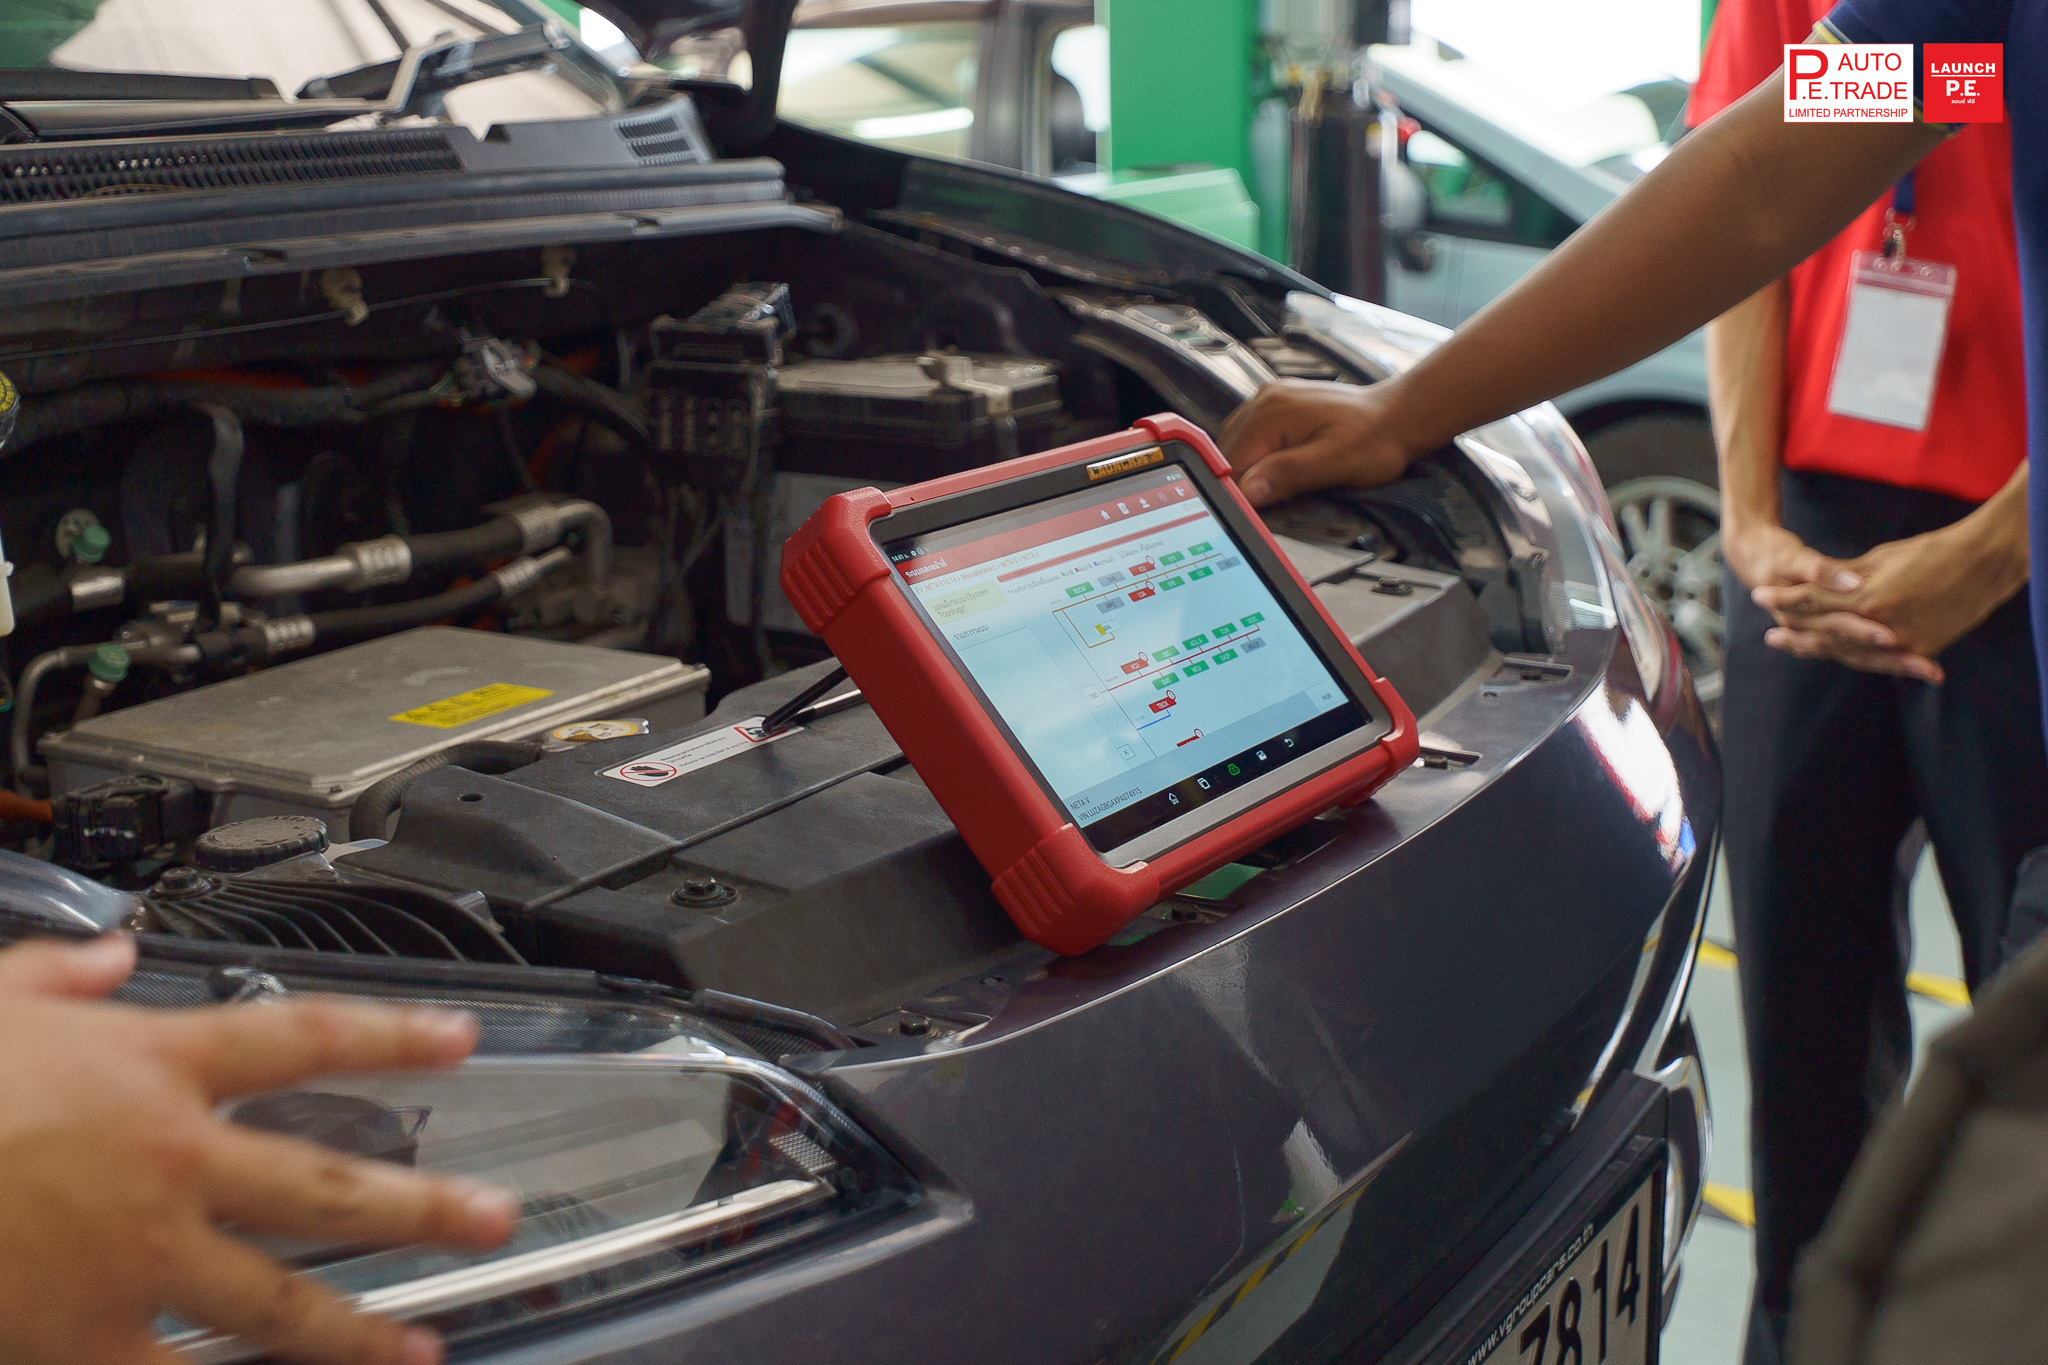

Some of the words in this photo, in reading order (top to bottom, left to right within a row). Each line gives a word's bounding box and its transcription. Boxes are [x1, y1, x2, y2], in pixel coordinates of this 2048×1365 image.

[906, 557, 947, 578] ระบบและหน้าที่
[915, 582, 939, 595] EV_NETA
[940, 576, 957, 589] V10.14
[961, 564, 997, 581] ManuallySelect
[1000, 557, 1013, 569] NETA
[1019, 552, 1034, 564] NETA
[966, 588, 990, 603] (System
[938, 604, 968, 619] Topology)
[954, 624, 989, 641] รายการระบบ
[1130, 662, 1141, 670] VCU
[1191, 665, 1202, 673] MCU
[1156, 700, 1170, 709] TBOX
[1070, 798, 1086, 811] NETA
[1085, 796, 1091, 804] V
[1077, 811, 1089, 821] VIN
[1519, 1203, 1641, 1365] 7814
[1468, 1222, 1594, 1365] www.vgroupcars.co.th
